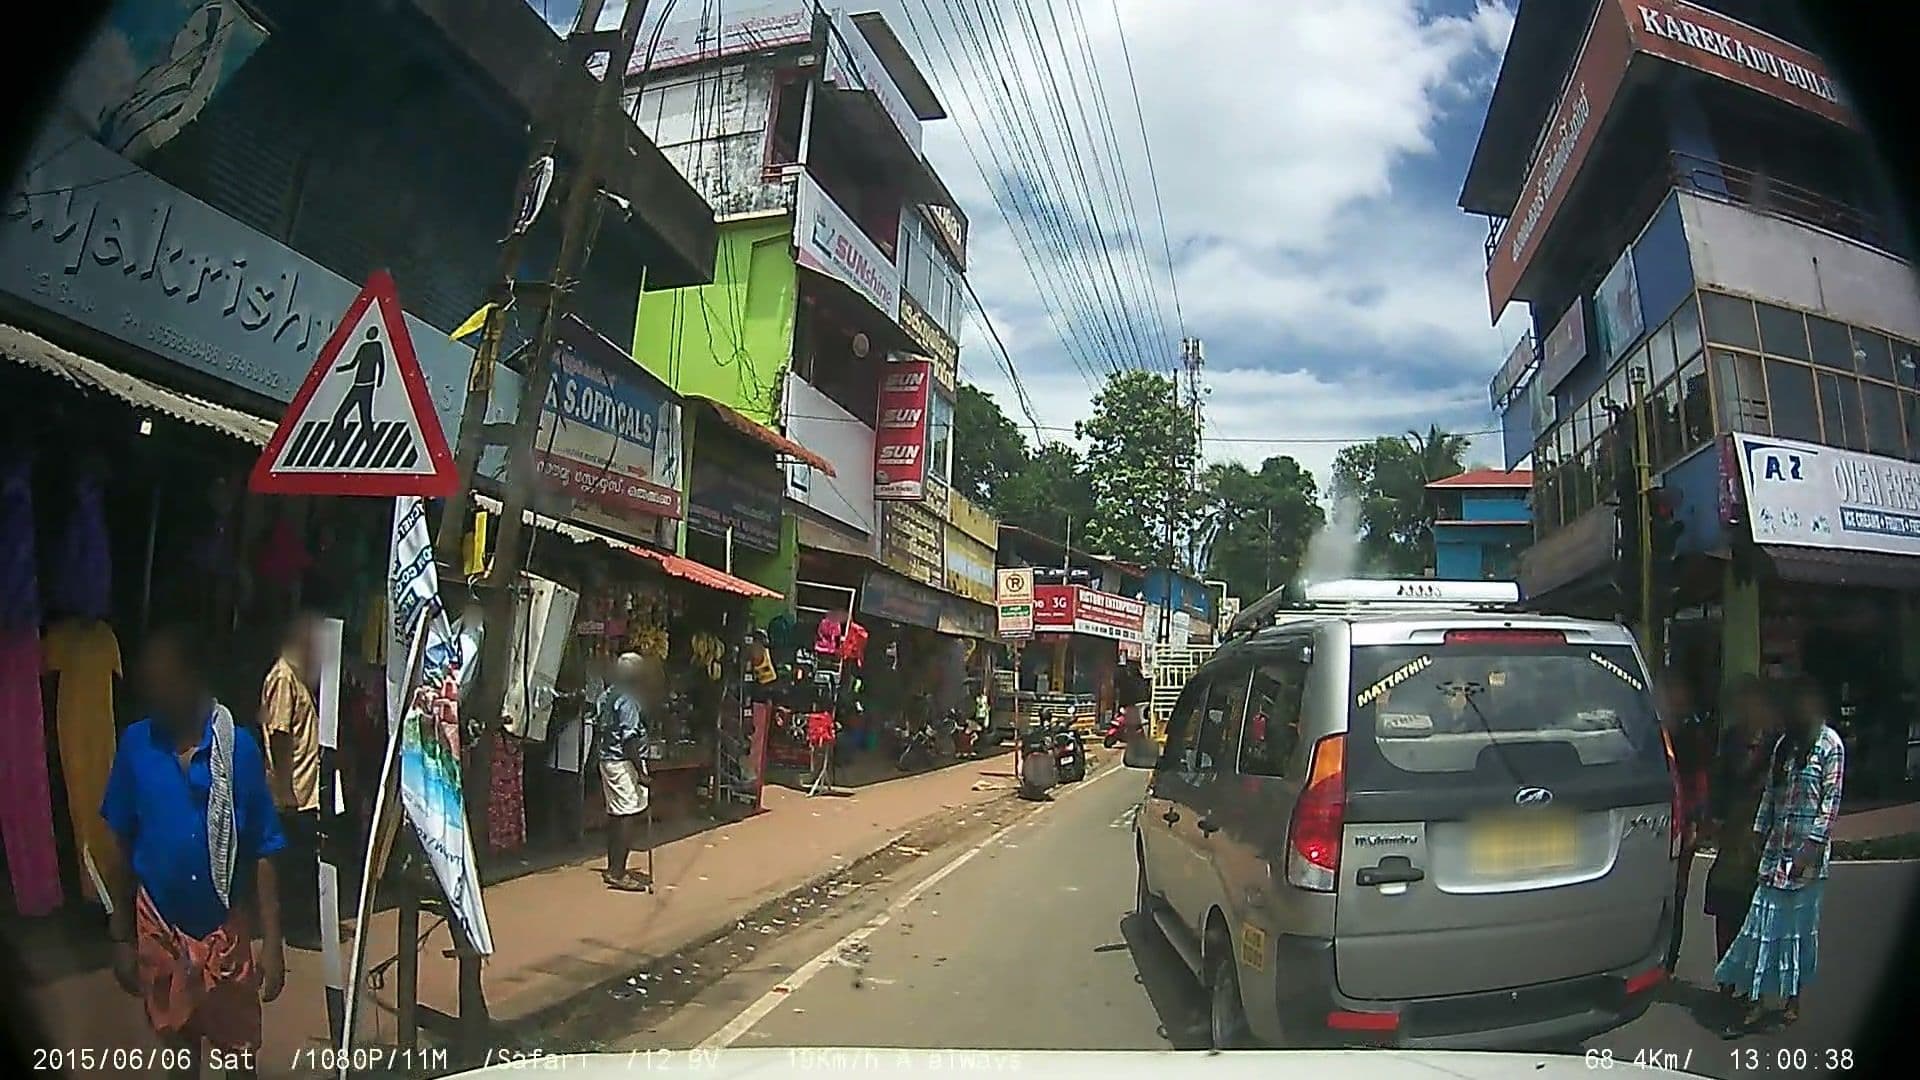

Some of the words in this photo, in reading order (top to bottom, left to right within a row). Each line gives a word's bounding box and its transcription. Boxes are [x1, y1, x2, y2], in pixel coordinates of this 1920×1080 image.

[1638, 5, 1779, 78] KAREKADU
[835, 234, 893, 306] SUNshine
[882, 408, 923, 422] SUN
[880, 445, 921, 459] SUN
[1765, 455, 1786, 481] A
[1052, 596, 1067, 609] 3G
[1357, 655, 1433, 708] MATTATHIL
